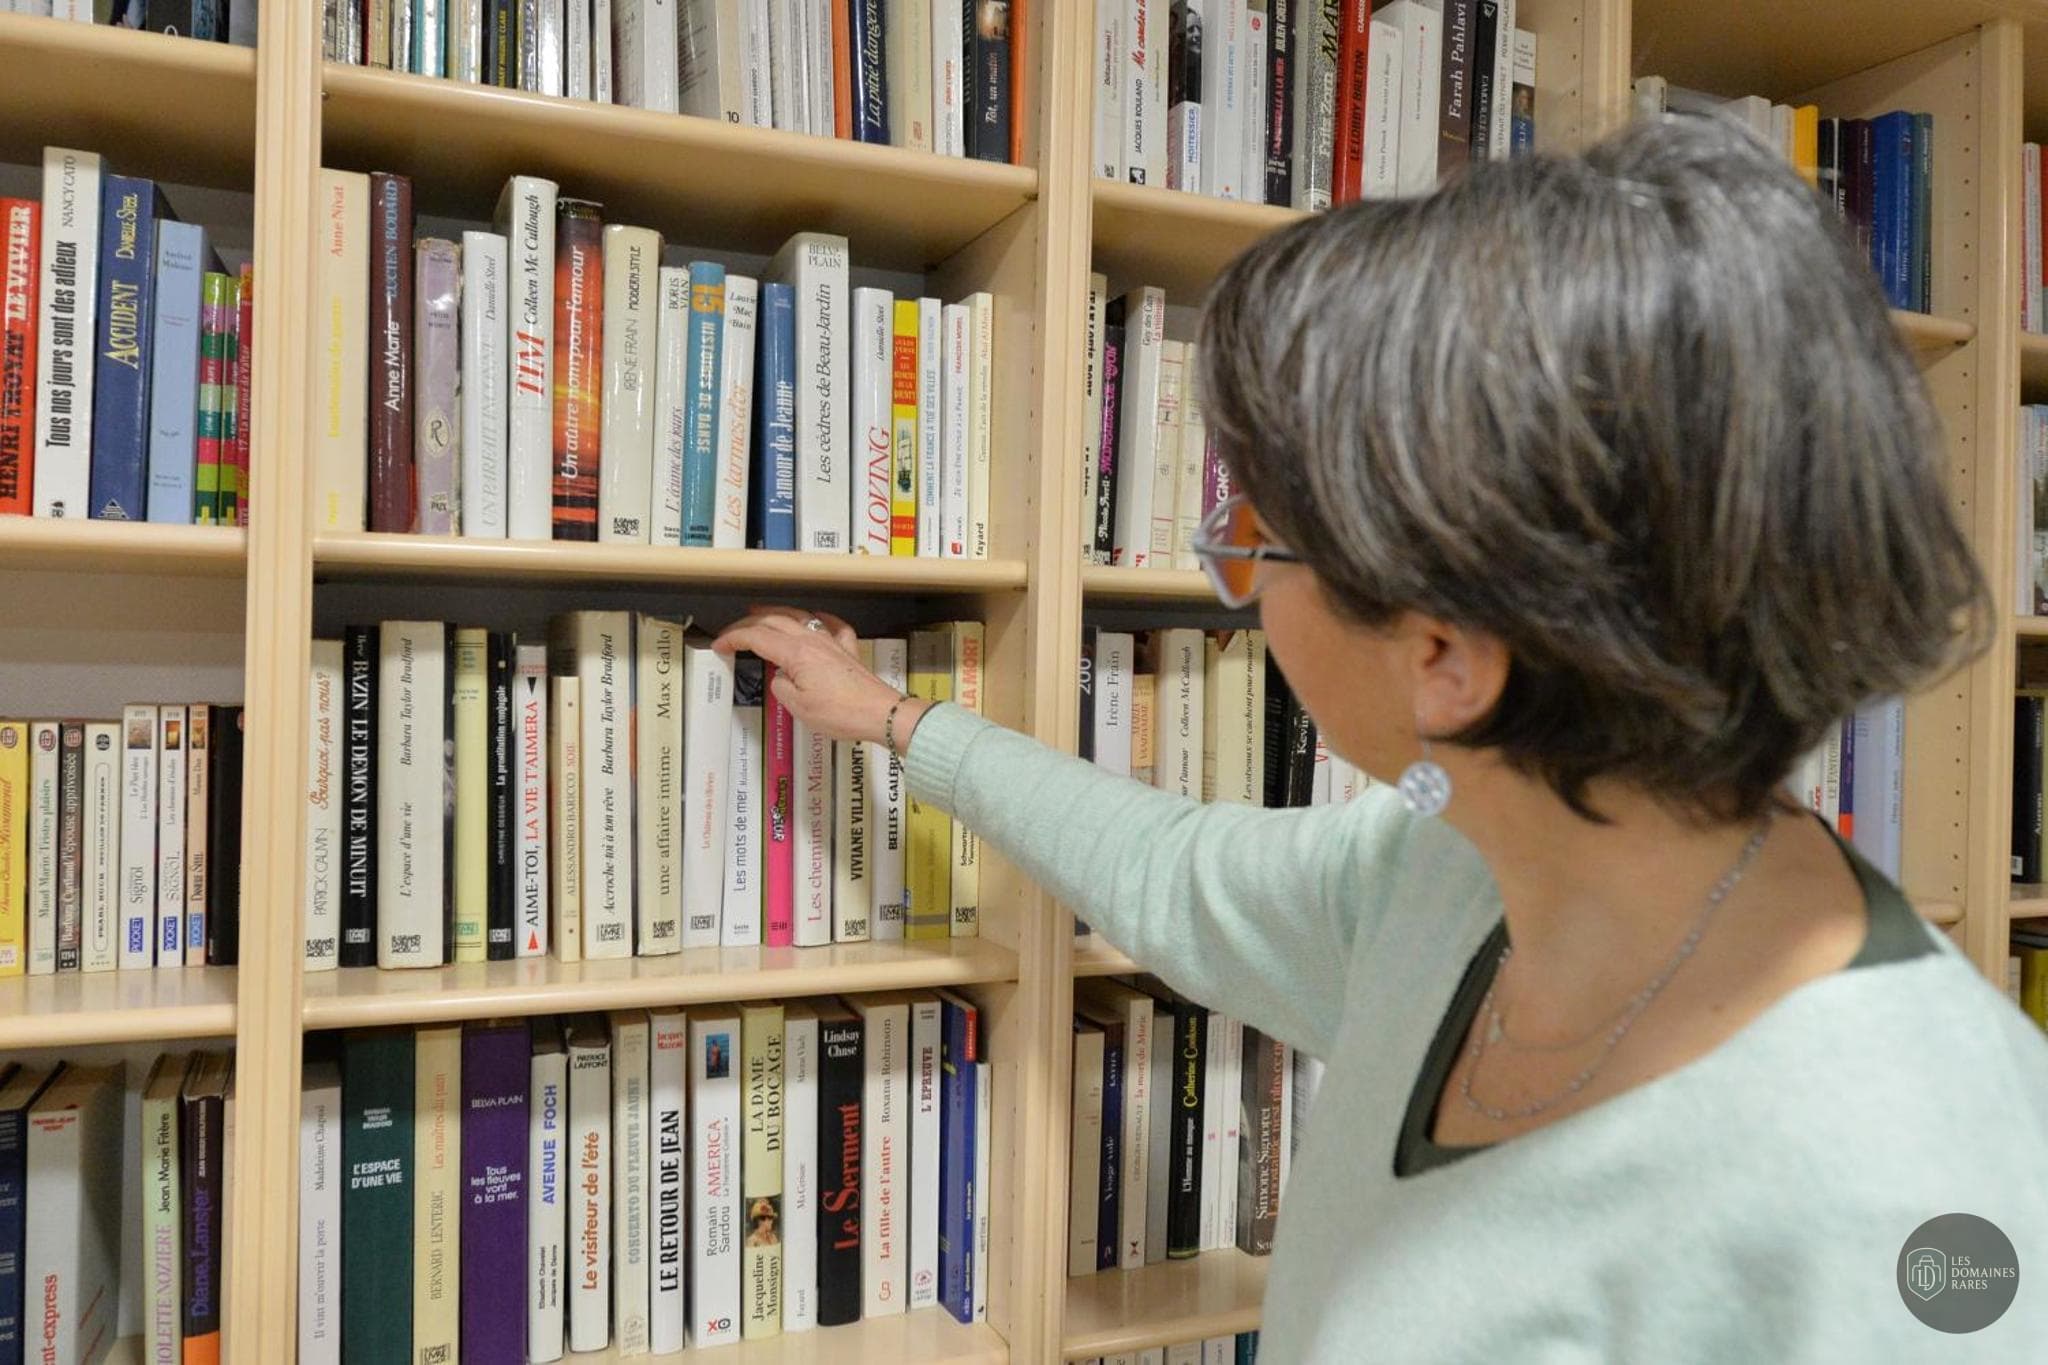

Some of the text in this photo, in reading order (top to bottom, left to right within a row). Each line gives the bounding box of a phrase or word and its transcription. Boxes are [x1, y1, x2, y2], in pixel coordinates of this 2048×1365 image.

[1448, 3, 1466, 117] Farah Pahlavi
[103, 193, 141, 370] ACCIDENT DANIELLE STEEL
[514, 194, 545, 397] TIM Colleen Mc Cullough
[672, 276, 684, 310] BORIS
[806, 255, 841, 269] PLAIN
[45, 156, 77, 448] Tous nos jours sont des adieux NANCY CATO
[384, 180, 401, 412] Anne Marie LUCIEN BODARD
[0, 206, 31, 499] HENRI TROYAT LE VIVIER
[561, 245, 585, 479] Un autre nom pour l'amour
[814, 283, 833, 484] Les cèdres de Beau-Jardin
[769, 380, 794, 515] L'amour de Jeanne
[974, 523, 986, 556] fayard
[601, 634, 616, 686] Bradford
[961, 636, 979, 709] LA MORT
[1106, 651, 1120, 727] Irène Frain
[602, 688, 617, 723] Taylor
[1179, 703, 1190, 738] Colleen
[1296, 715, 1309, 755] Kevin
[63, 753, 79, 813] apprivoisée
[350, 659, 368, 898] BAZIN LE DEMON DE MINUIT
[399, 637, 415, 898] L'espace d'une vie Barbara Taylor Bradford
[601, 727, 615, 775] Barbara
[656, 628, 671, 896] une affaire intime Max Gallo
[39, 779, 53, 816] plaisirs
[309, 672, 333, 916] PATRICK CAUVIN Pourquoi pas nous?
[524, 702, 541, 928] AIME-TOI, LA VIE T'AIMERA
[566, 743, 576, 897] ALESSANDRO BARICCO SOIE
[601, 787, 615, 811] rêve
[602, 812, 614, 832] ton
[807, 732, 824, 922] Les chemins de Maison
[851, 748, 864, 881] VIVIANE VILLAMONT
[39, 856, 50, 887] Marin
[61, 816, 77, 860] l'épouse
[38, 890, 50, 918] Maud
[130, 866, 146, 904] Signol
[602, 843, 616, 915] Accroche-toi
[60, 904, 75, 942] Barbara
[129, 917, 142, 953] POCKET
[164, 916, 177, 951] POCKET
[189, 913, 203, 948] POCKET
[573, 1060, 608, 1070] LAFFONT
[823, 1030, 860, 1045] Lindsay
[826, 1042, 855, 1058] Chase
[751, 1056, 764, 1133] LA DAME
[767, 1033, 782, 1152] DU BOCAGE
[352, 1159, 401, 1176] L'ESPACE
[486, 1165, 508, 1176] Tous
[542, 1084, 557, 1204] AVENUE FOCH
[628, 1077, 640, 1265] CONCERTO DU FLEUVE JAUNE
[707, 1119, 721, 1198] AMERICA
[880, 1018, 892, 1259] La fille de l'autre Roxana Robinson
[1255, 1107, 1272, 1220] Simone Signoret
[351, 1172, 402, 1190] D'UNE VIE
[470, 1172, 522, 1187] les fleuves
[485, 1184, 508, 1194] vont
[660, 1109, 681, 1292] LE RETOUR DE JEAN
[822, 1103, 860, 1251] Le Serment
[313, 1105, 328, 1339] Il vint m'ouvrir la porte Madeleine Chapsal
[582, 1132, 599, 1290] Le visiteur de l'été
[706, 1206, 718, 1257] Romain
[718, 1205, 730, 1253] Sardou
[752, 1254, 766, 1321] Jacqueline
[766, 1255, 781, 1317] Monsigny
